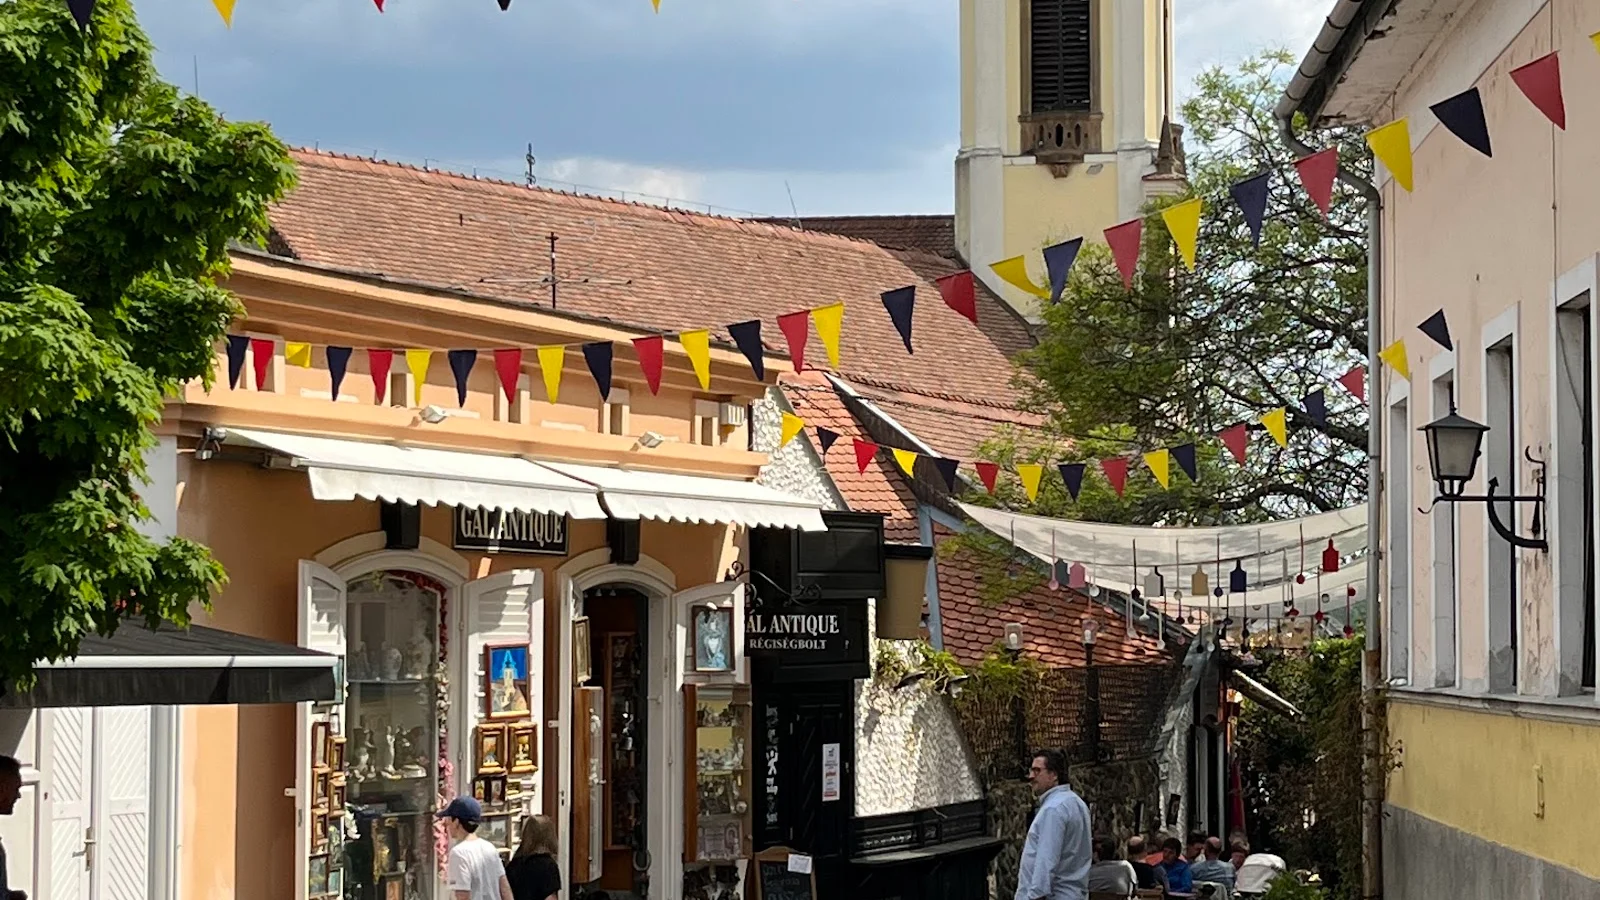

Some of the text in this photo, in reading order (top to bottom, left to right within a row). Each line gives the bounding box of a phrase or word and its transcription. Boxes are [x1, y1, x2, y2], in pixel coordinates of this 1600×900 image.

[496, 509, 564, 547] ANTIQUE
[745, 608, 840, 636] ÁL ANTIQUE
[749, 637, 827, 650] RÉGISÉGBOLT
